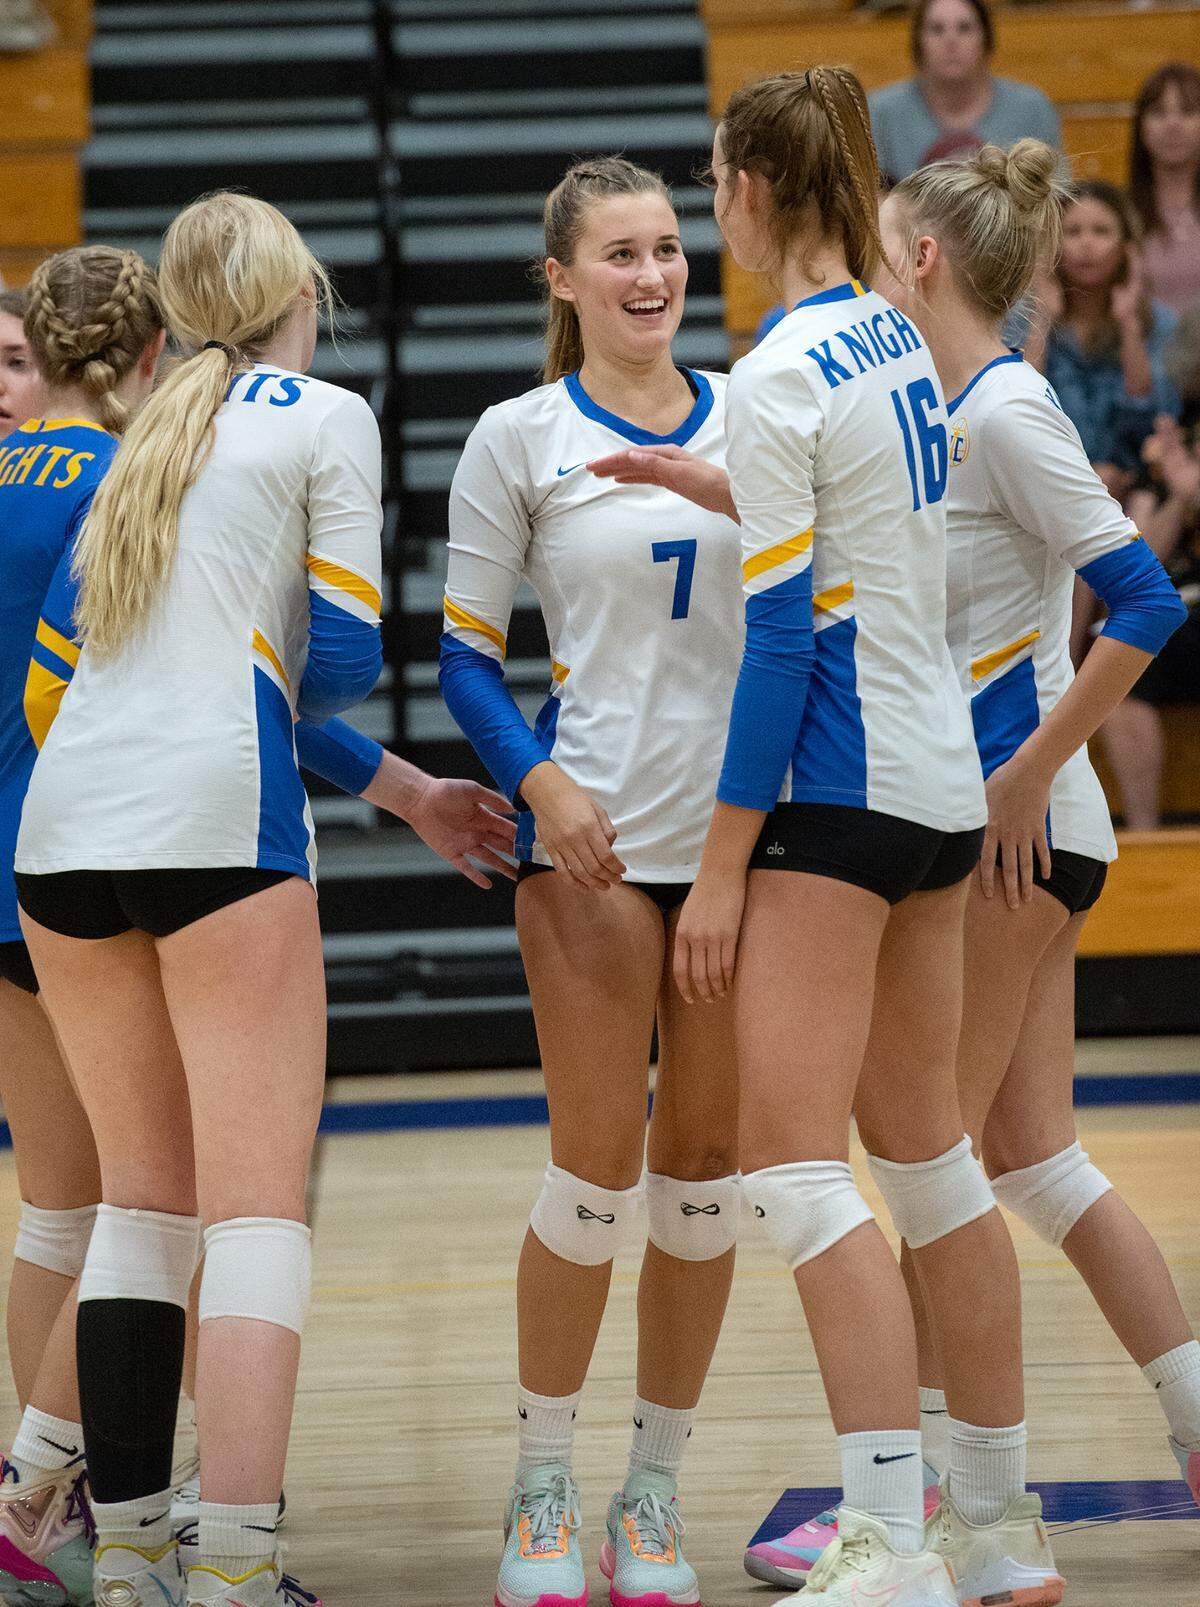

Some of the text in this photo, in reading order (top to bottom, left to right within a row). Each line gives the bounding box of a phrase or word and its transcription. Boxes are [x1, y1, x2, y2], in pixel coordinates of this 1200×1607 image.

[805, 308, 922, 389] KNIGH
[890, 377, 947, 512] 16
[651, 538, 698, 620] 7
[766, 841, 785, 855] alo
